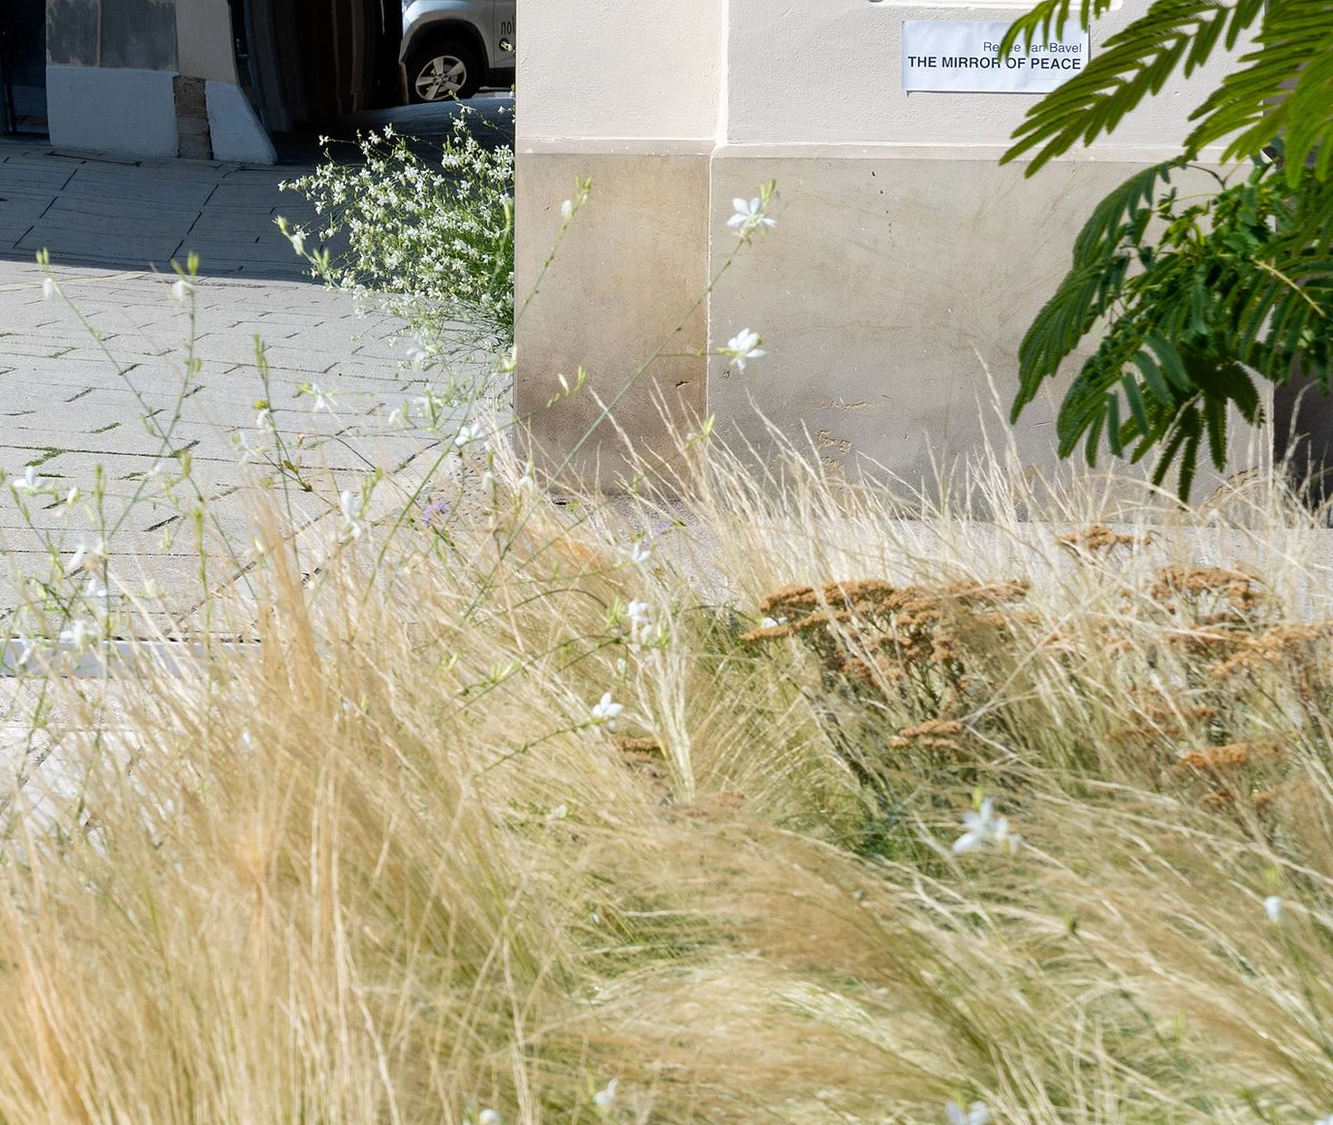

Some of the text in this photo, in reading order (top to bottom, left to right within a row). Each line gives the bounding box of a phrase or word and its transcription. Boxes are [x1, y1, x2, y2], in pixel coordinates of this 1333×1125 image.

[983, 41, 1022, 53] Ree
[1049, 42, 1082, 53] Bavel
[907, 56, 1082, 70] THE MIRROR OF PEACE
